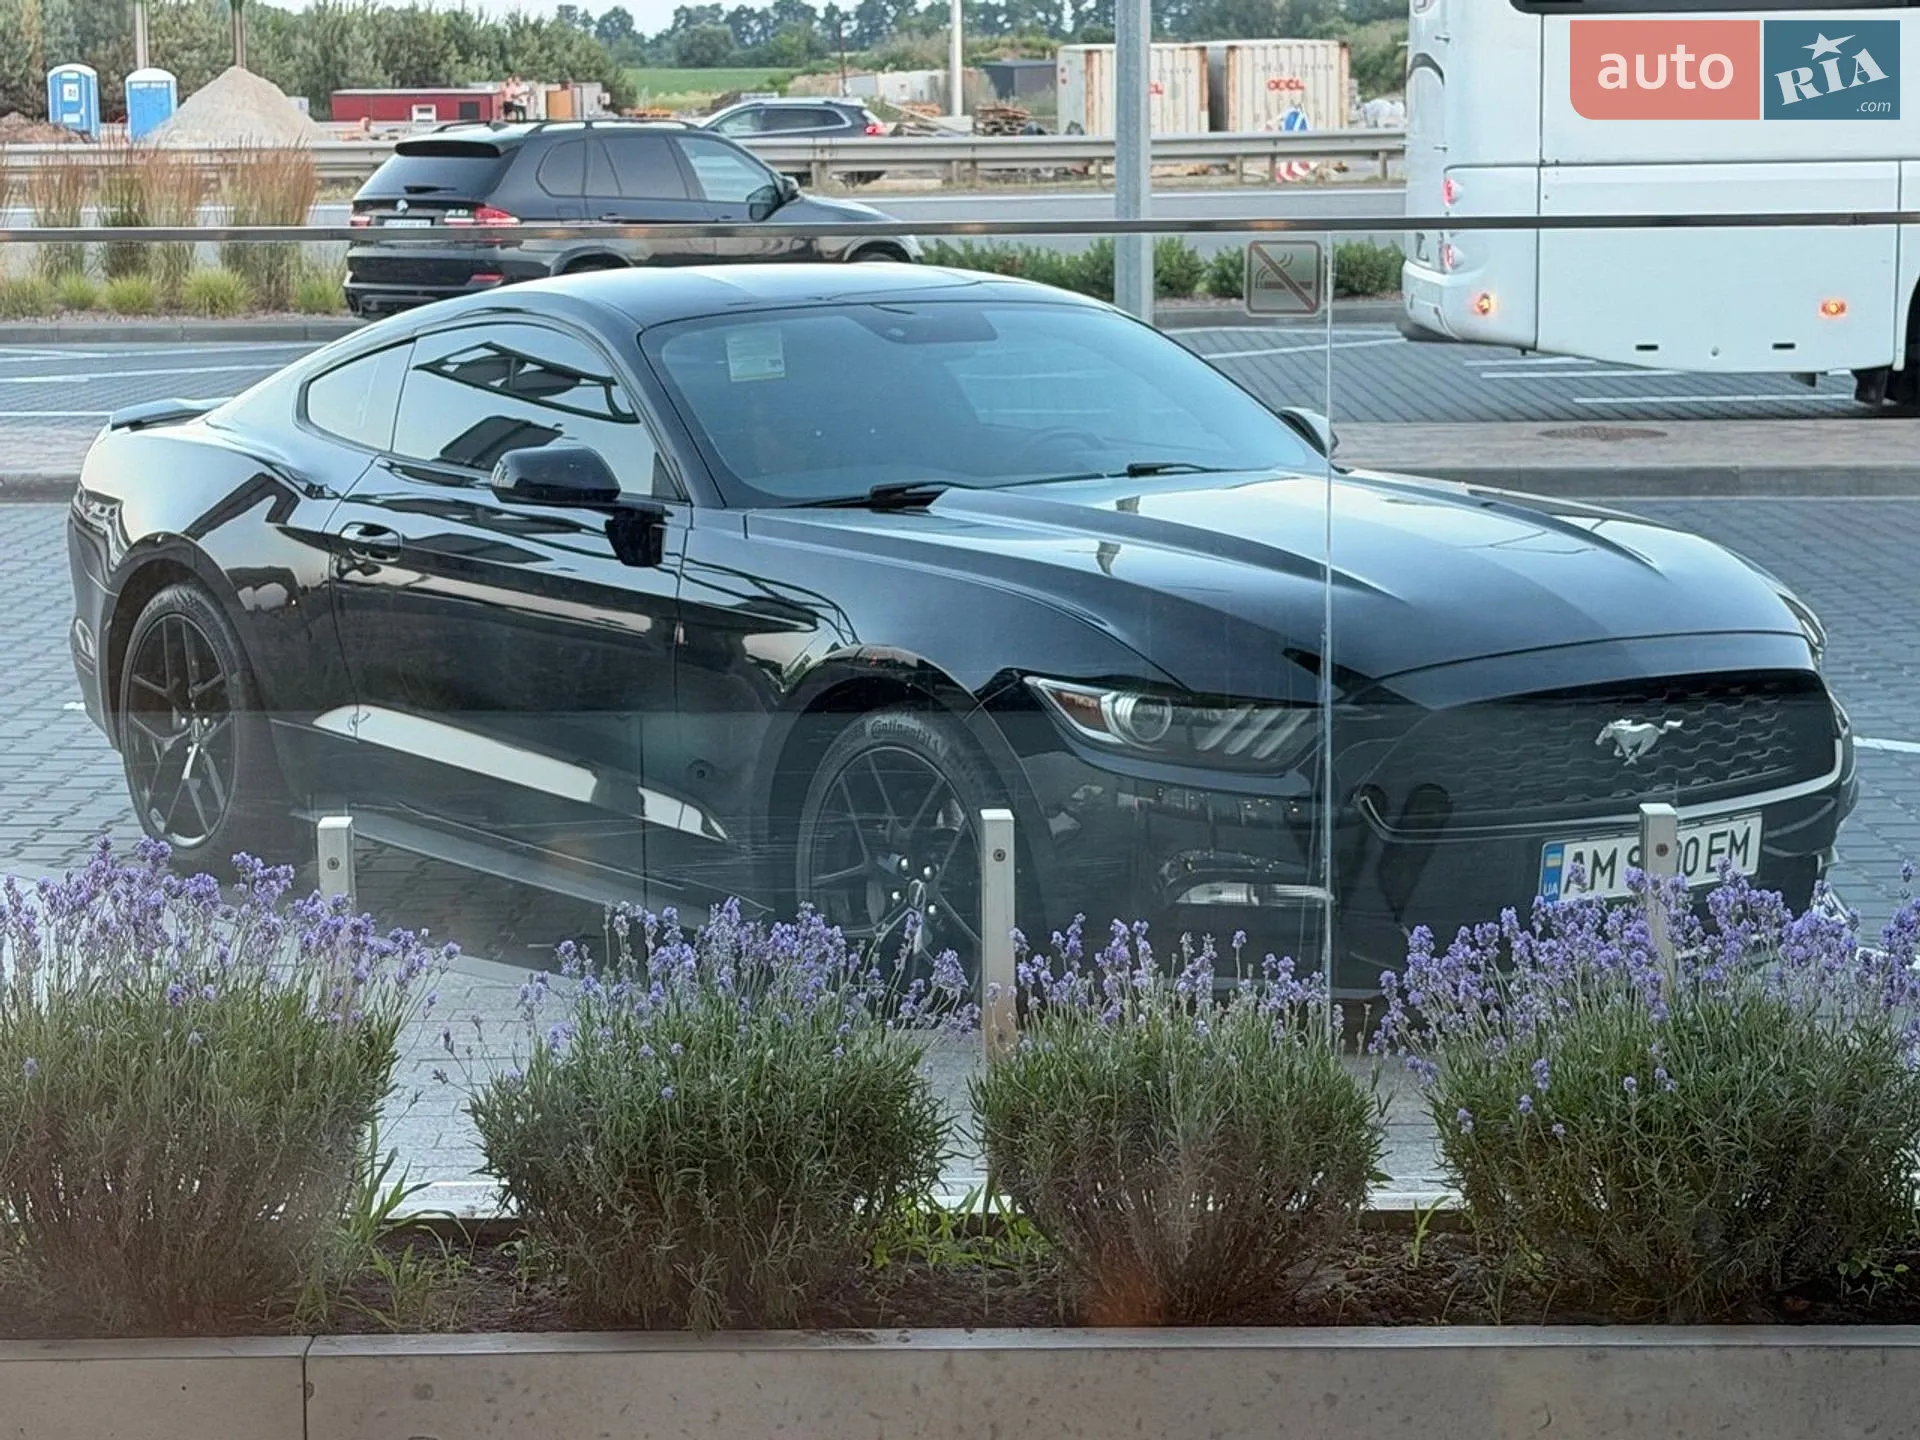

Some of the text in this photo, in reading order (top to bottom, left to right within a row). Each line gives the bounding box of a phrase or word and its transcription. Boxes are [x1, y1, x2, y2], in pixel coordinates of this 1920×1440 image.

[1563, 847, 1618, 894] AM
[1706, 826, 1751, 874] EM
[1543, 881, 1559, 897] UA
